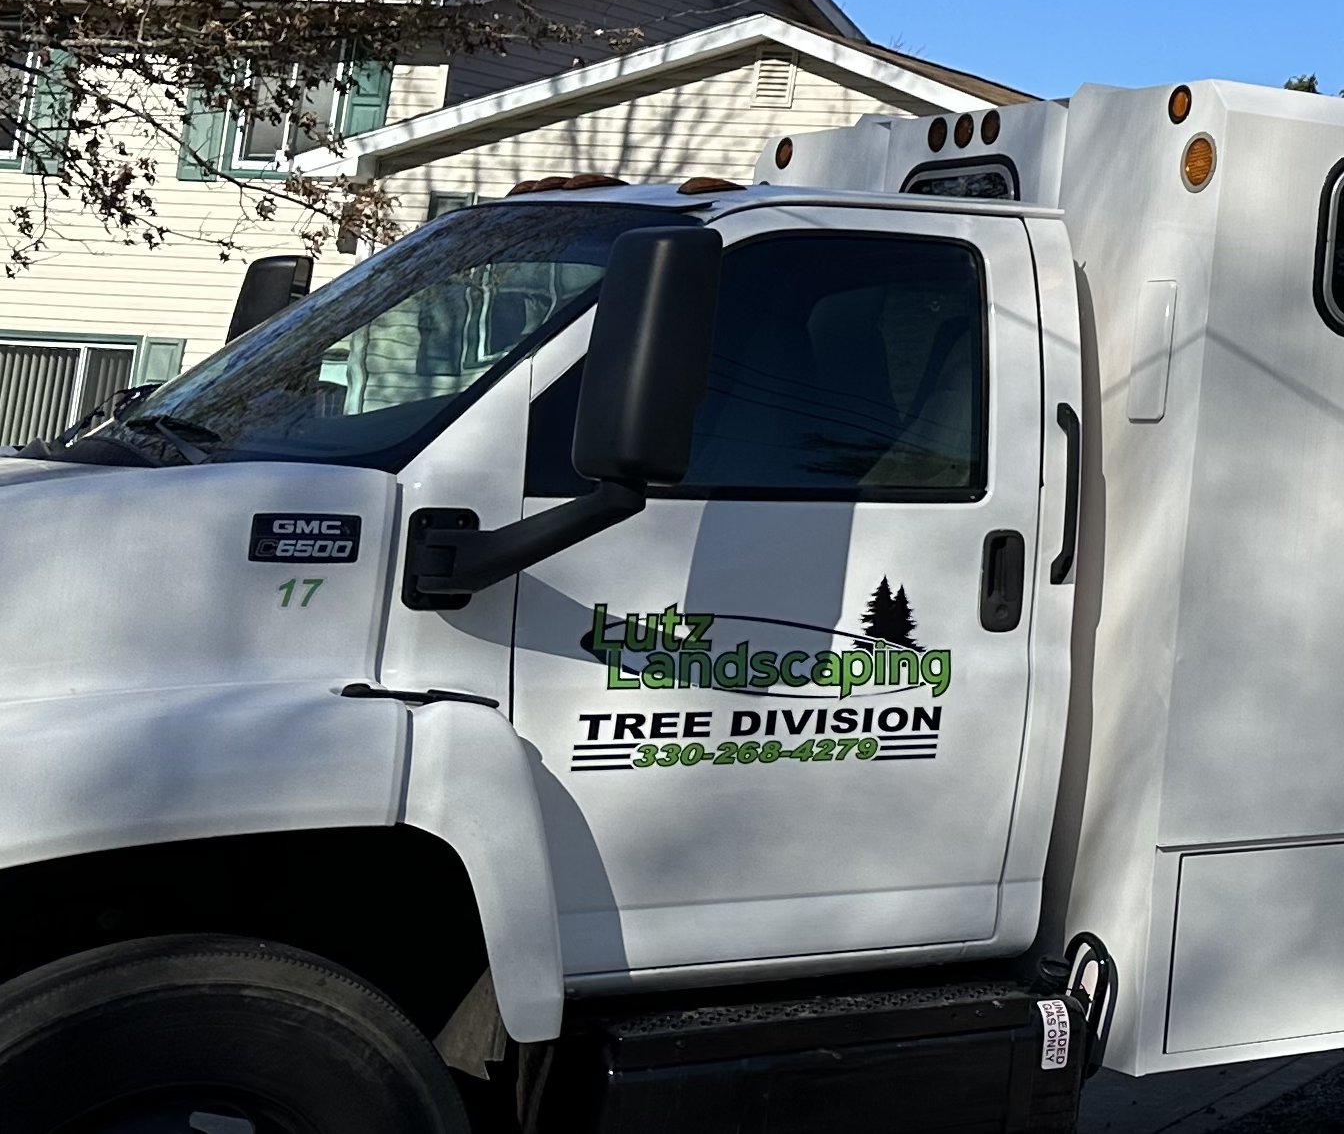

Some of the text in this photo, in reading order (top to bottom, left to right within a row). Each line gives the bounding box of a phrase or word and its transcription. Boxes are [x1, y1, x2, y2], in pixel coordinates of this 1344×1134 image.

[272, 519, 342, 535] GMC
[279, 577, 324, 608] 17
[593, 603, 715, 651] Lutz
[606, 641, 952, 701] Landscaping
[579, 706, 943, 741] TREE DIVISION
[633, 737, 881, 768] 330-268-4279
[1042, 1003, 1057, 1063] GAS ONLY
[1051, 1000, 1068, 1065] UNLEADED
